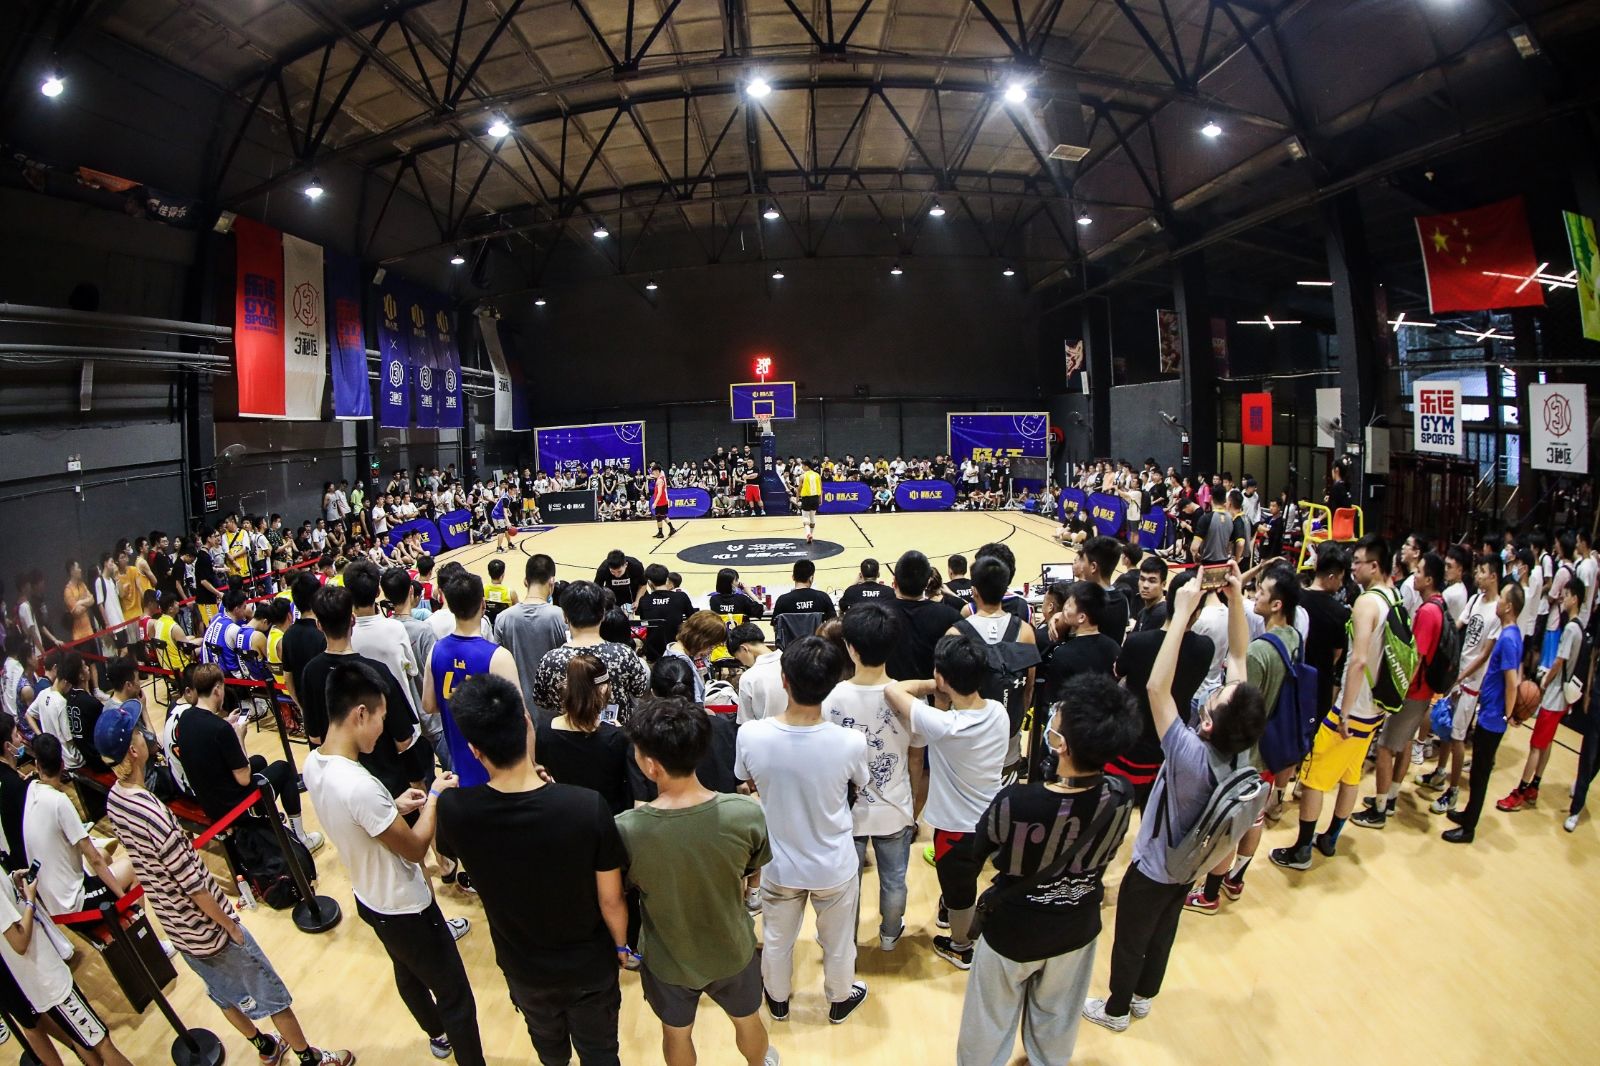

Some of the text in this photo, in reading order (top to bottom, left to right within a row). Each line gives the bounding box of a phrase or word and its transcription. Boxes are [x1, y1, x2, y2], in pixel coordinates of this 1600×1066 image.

[294, 336, 318, 356] 3秒区
[1420, 415, 1455, 433] GYM
[1421, 432, 1455, 446] SPORTS
[1546, 447, 1572, 465] 3秒区
[652, 597, 670, 605] STAFF
[719, 604, 735, 612] STAFF
[795, 600, 814, 610] STAFF
[1384, 644, 1410, 690] LI-NING
